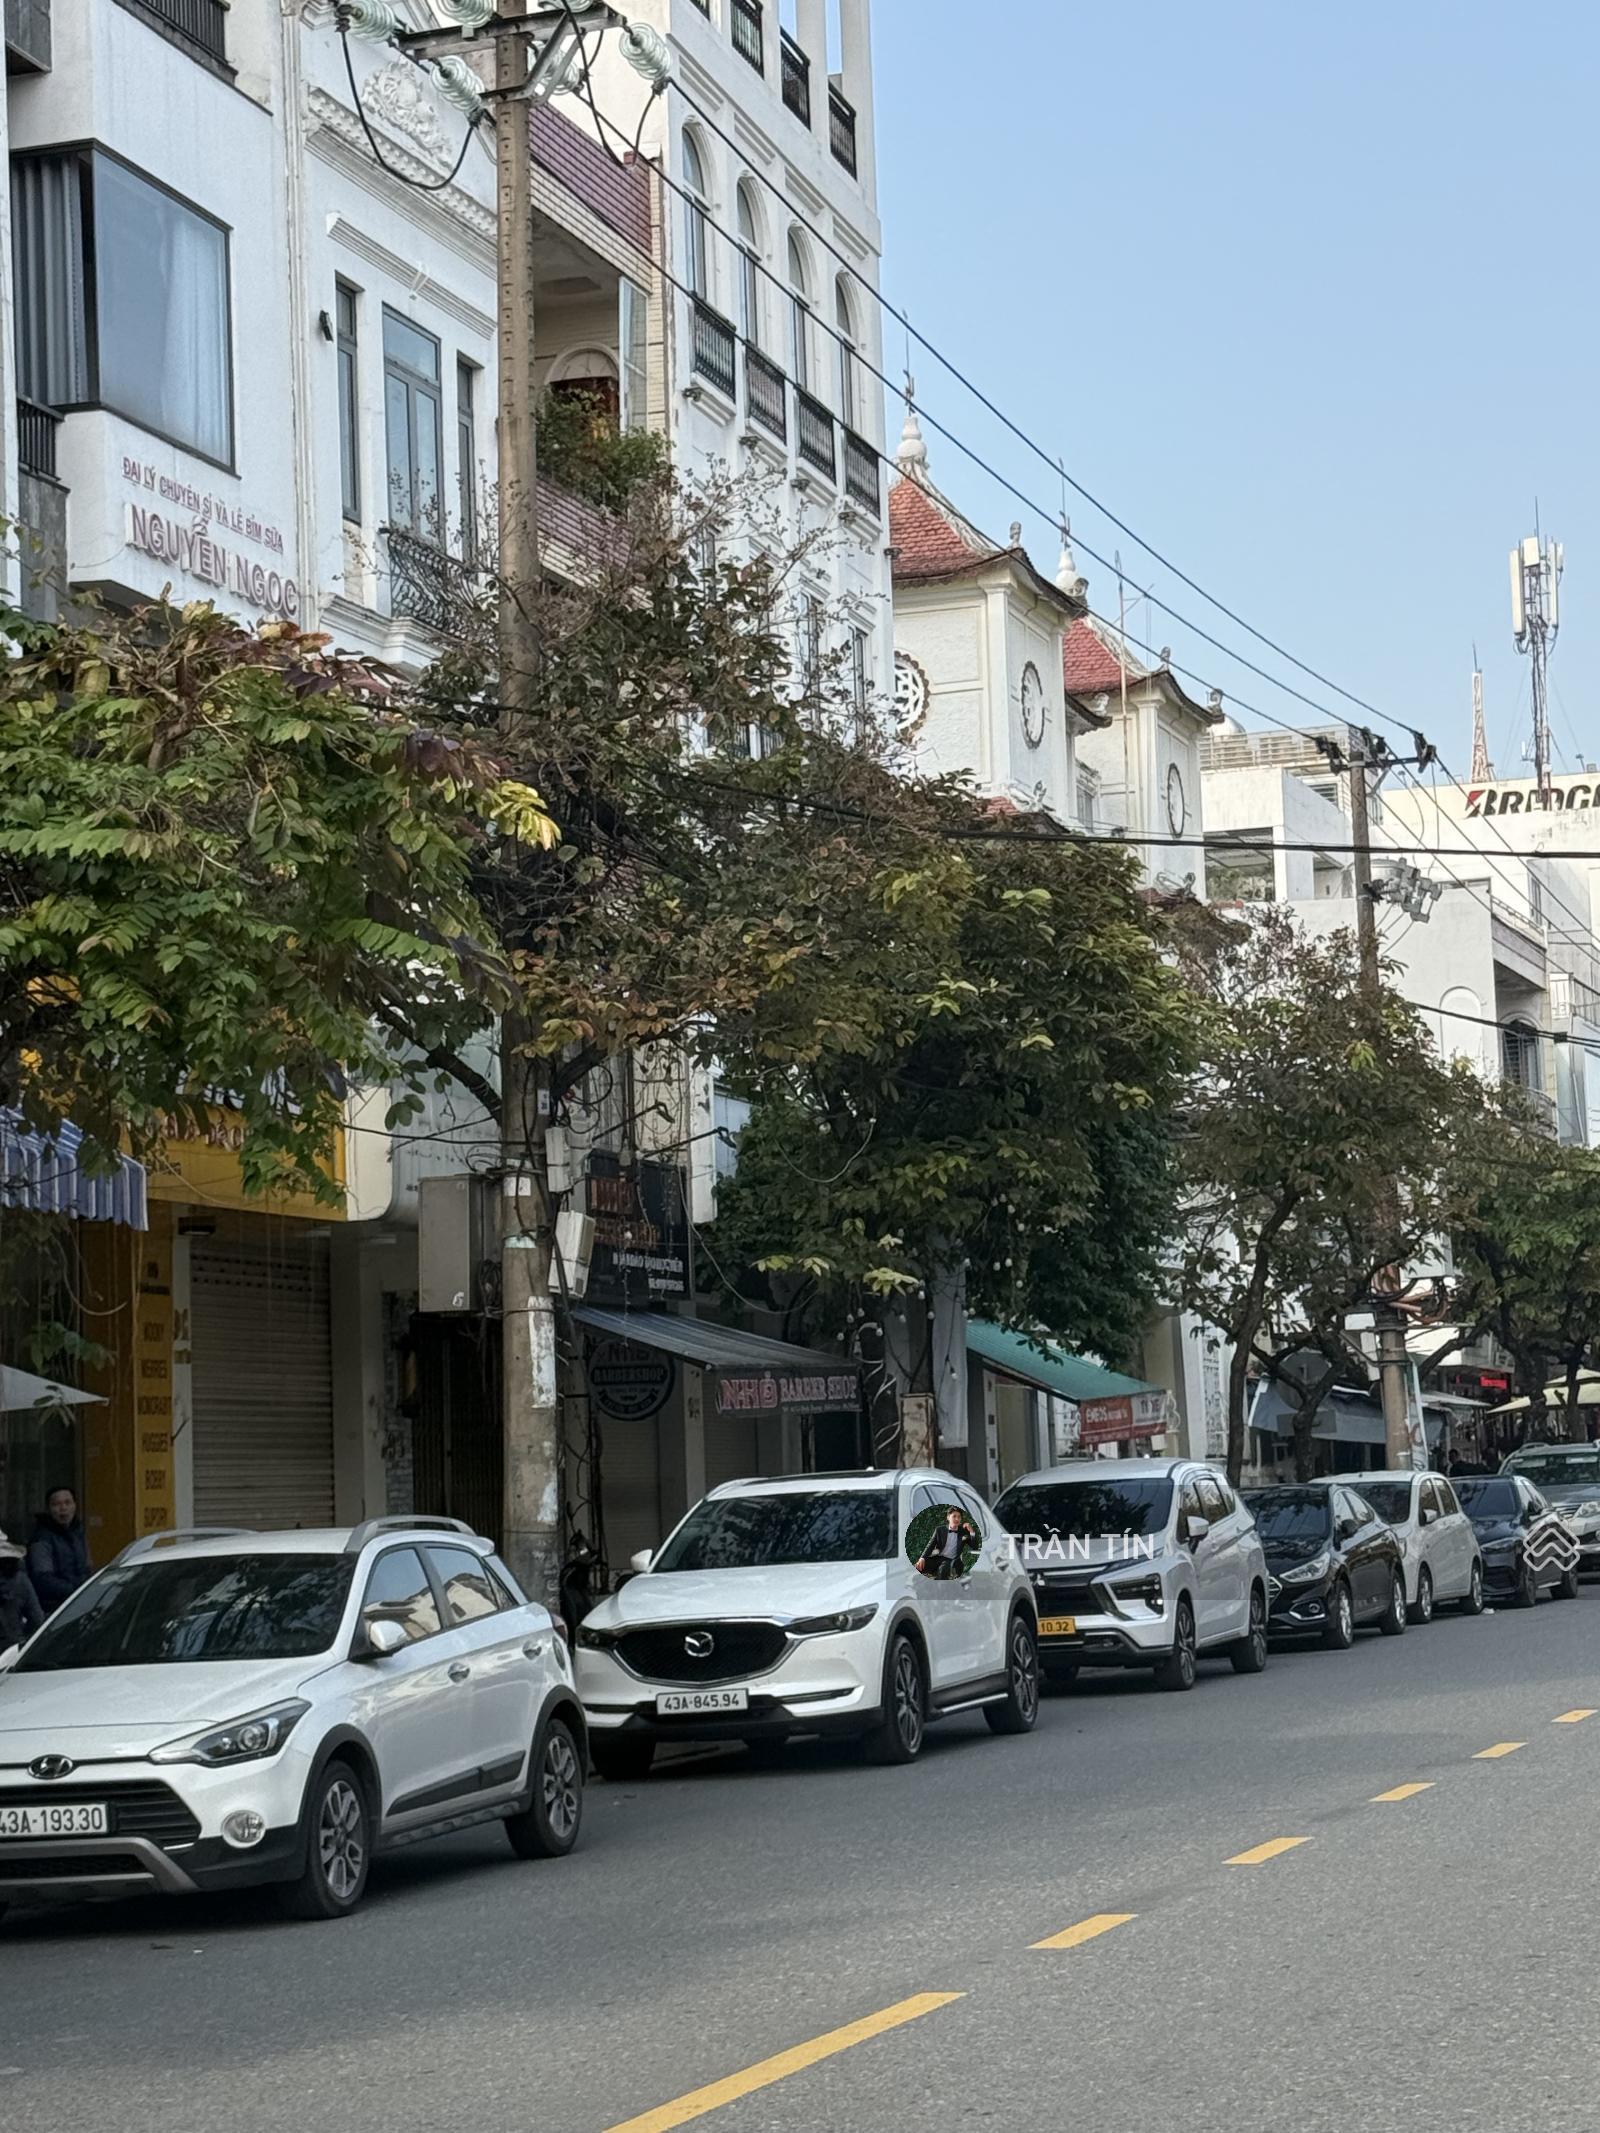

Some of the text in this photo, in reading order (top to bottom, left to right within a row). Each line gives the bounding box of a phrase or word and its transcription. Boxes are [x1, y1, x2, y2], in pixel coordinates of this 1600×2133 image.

[779, 1378, 826, 1402] BARBER
[827, 1375, 857, 1400] SHOP
[664, 1693, 740, 1710] 43A-845.94
